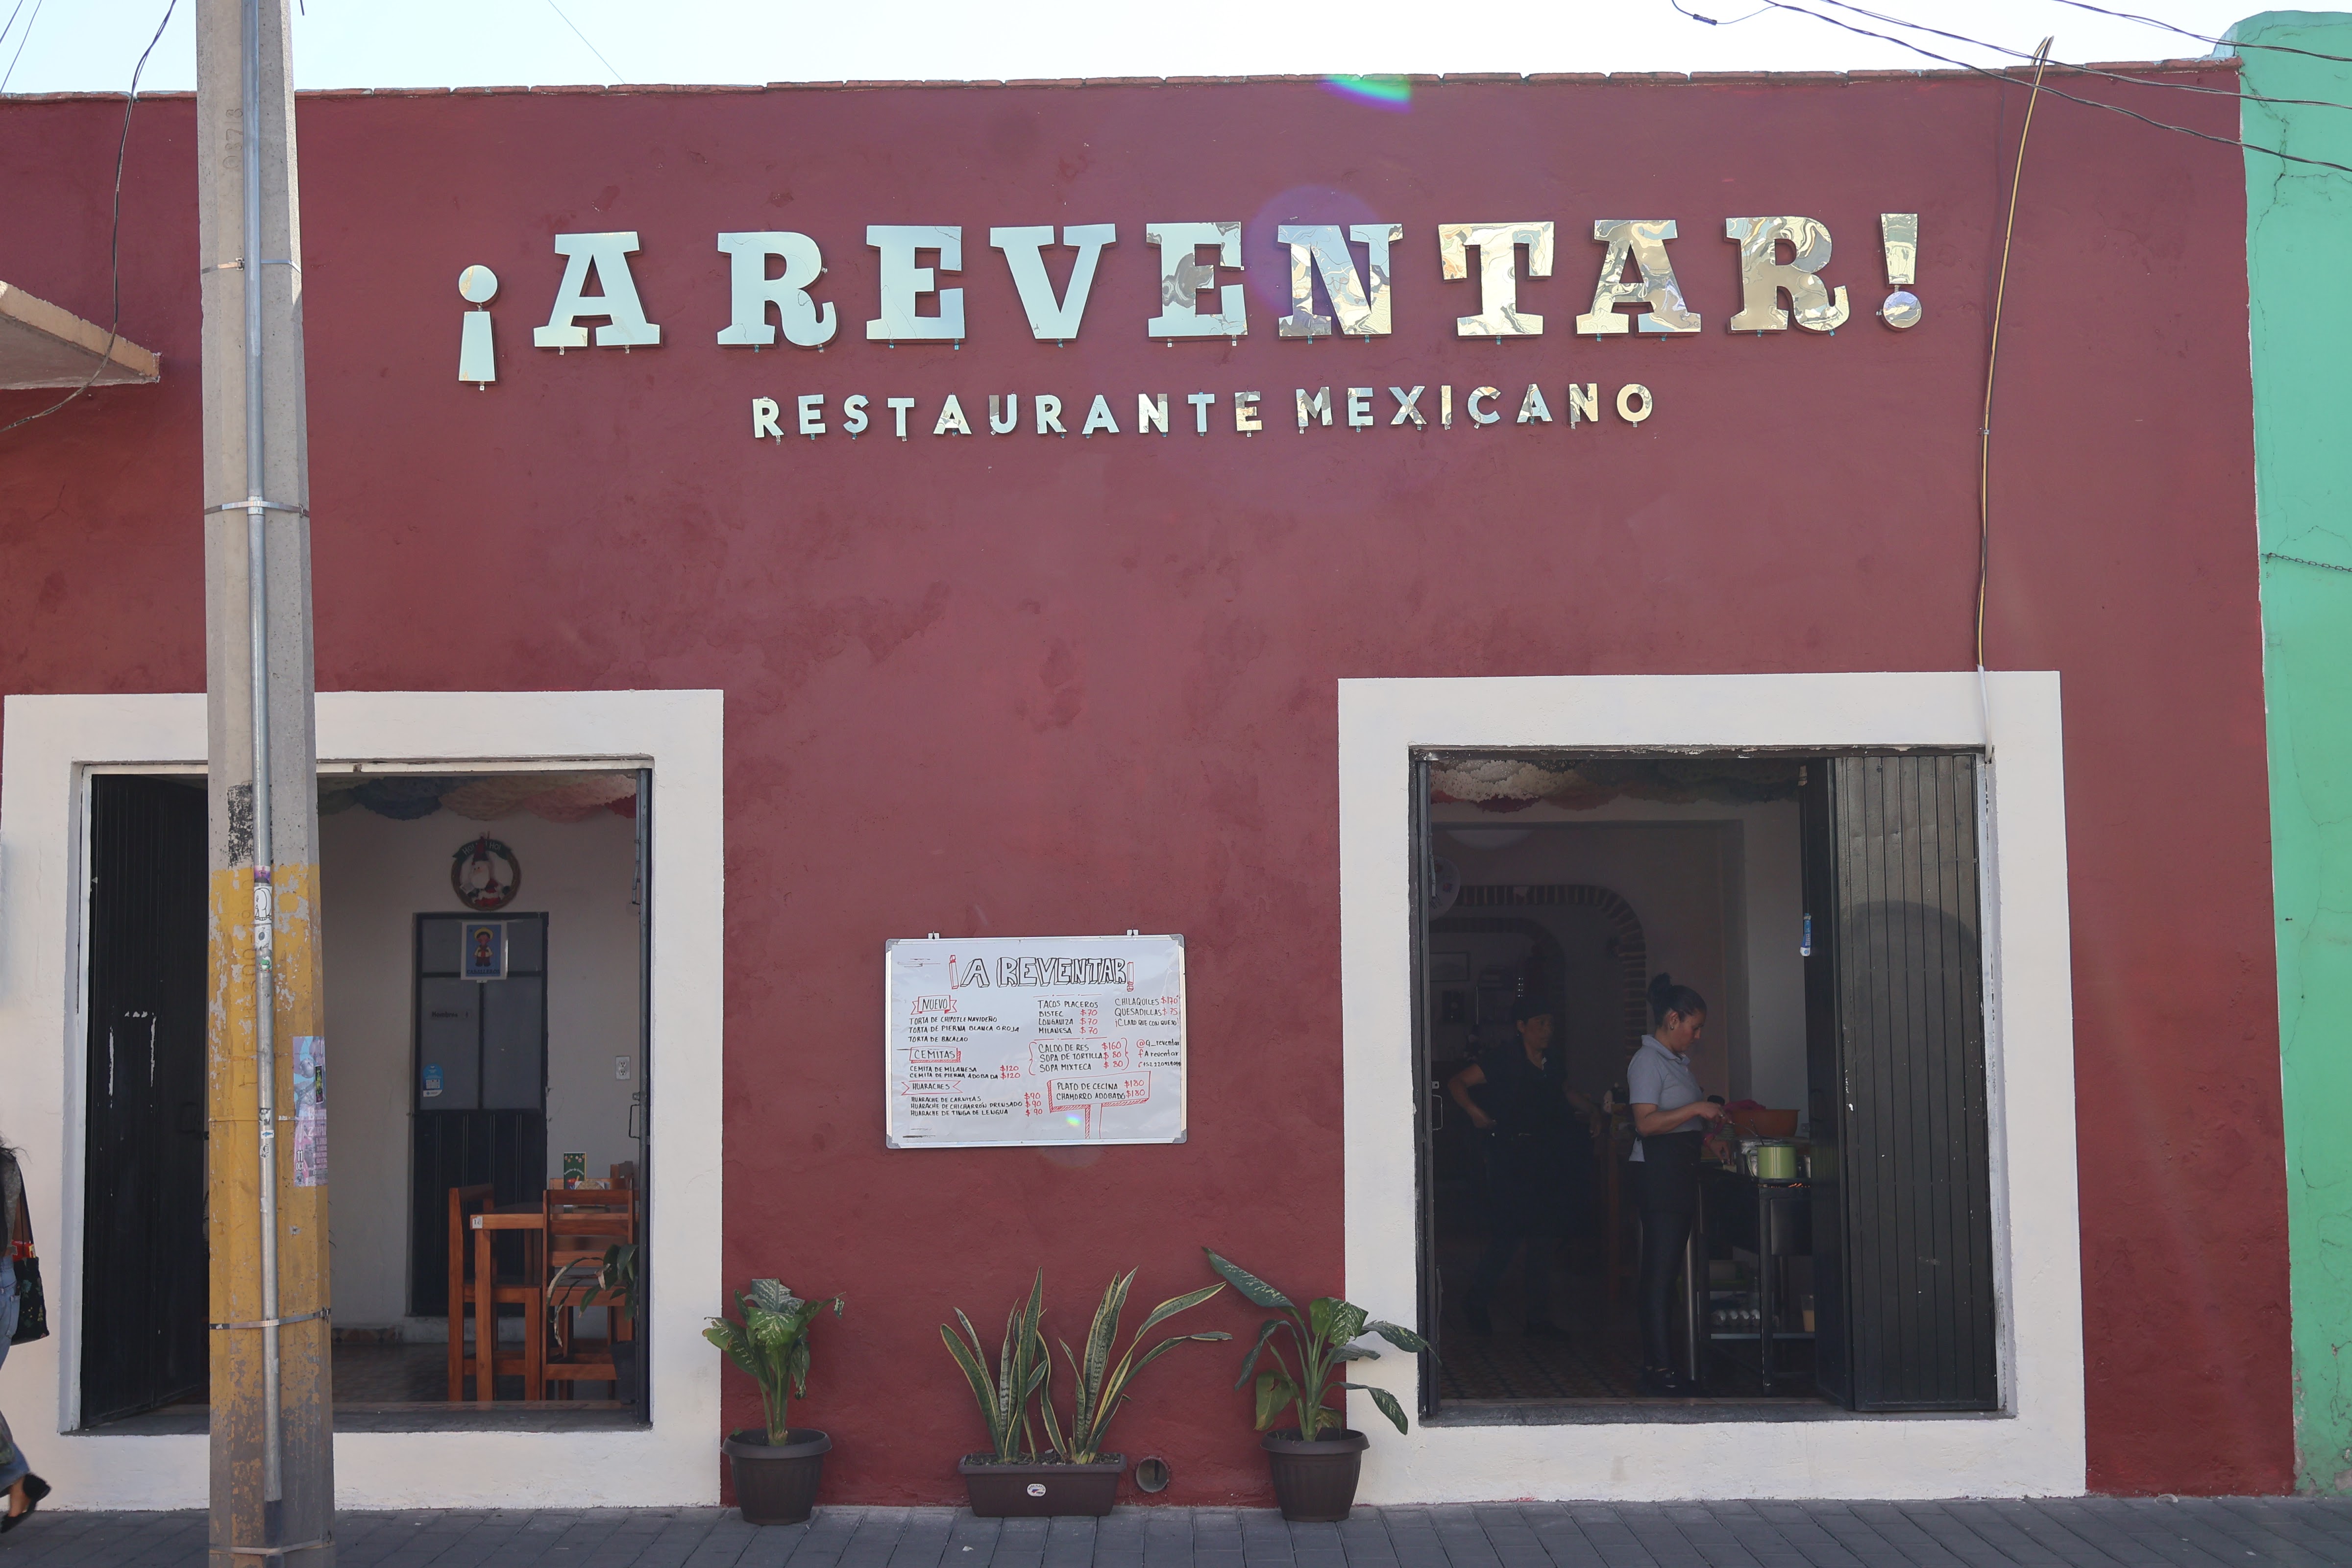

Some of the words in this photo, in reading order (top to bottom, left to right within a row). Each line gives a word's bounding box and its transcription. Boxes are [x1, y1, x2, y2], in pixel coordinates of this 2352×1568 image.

[717, 213, 1922, 346] REVENTAR!
[752, 391, 1263, 440] RESTAURANTE
[1296, 383, 1653, 427] MEXICANO
[996, 957, 1134, 992] REVENTAR!
[922, 998, 948, 1010] NUEVO
[1038, 1000, 1061, 1009] TACOS
[1115, 997, 1159, 1006] CHILAQUILES
[1160, 996, 1178, 1004] $170
[1114, 1008, 1162, 1017] QUESADILLAS
[909, 1017, 929, 1025] TORTA
[1038, 1044, 1063, 1053] CALDO
[1102, 1041, 1122, 1051] $160
[914, 1050, 956, 1059] CEMITAS
[1040, 1054, 1058, 1063] SOPA
[1039, 1063, 1058, 1072] SOPA
[1057, 1082, 1078, 1091] PLATO
[1124, 1079, 1145, 1089] $180
[1126, 1089, 1146, 1099] $180
